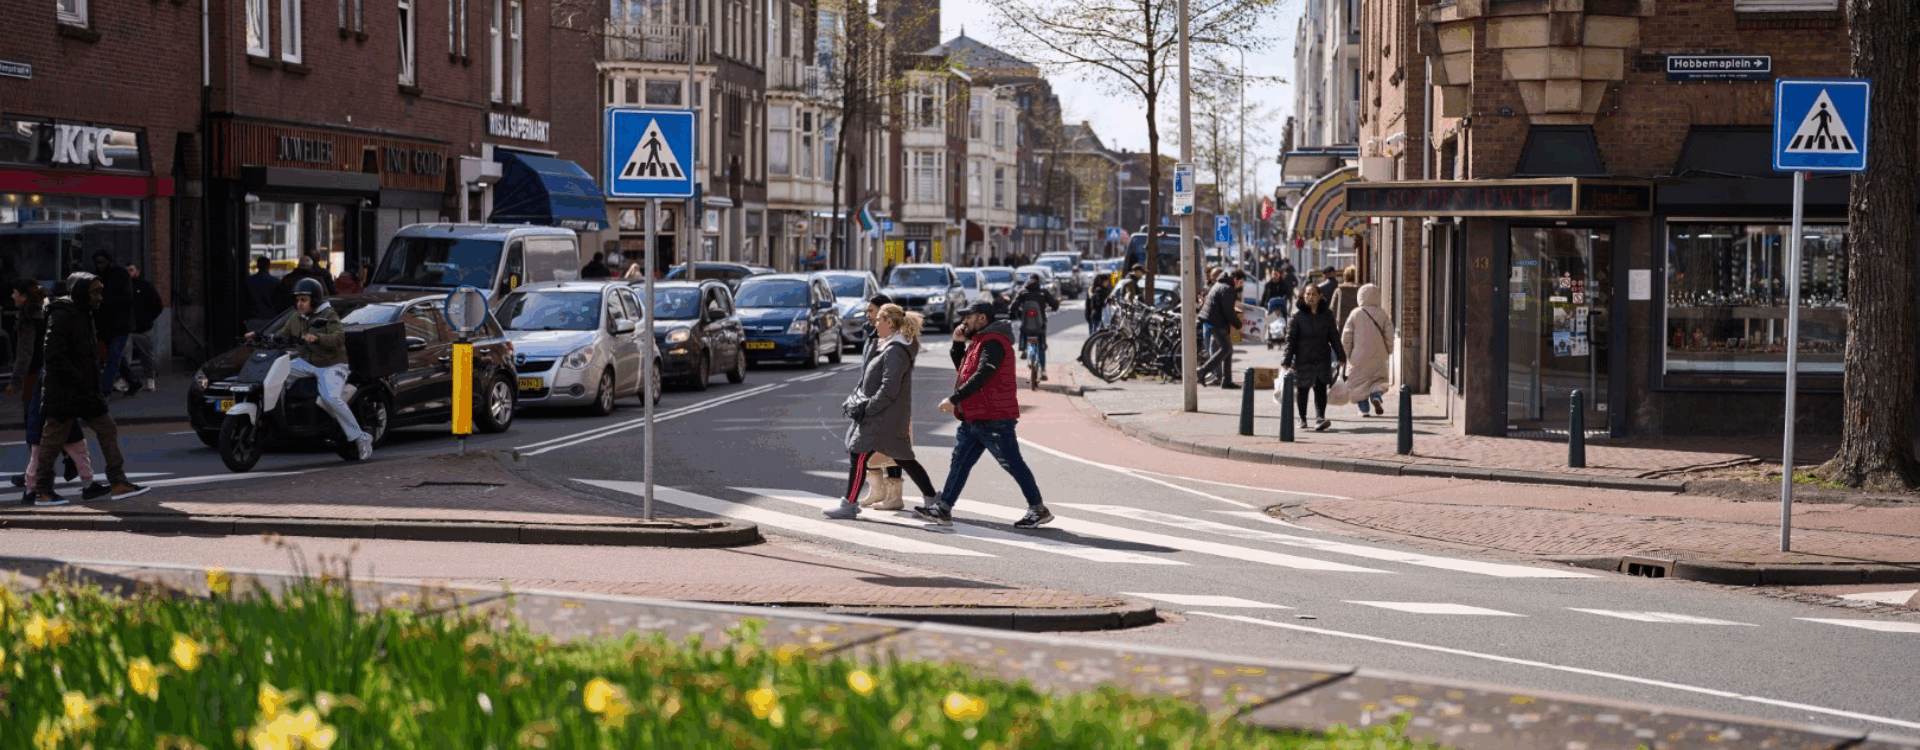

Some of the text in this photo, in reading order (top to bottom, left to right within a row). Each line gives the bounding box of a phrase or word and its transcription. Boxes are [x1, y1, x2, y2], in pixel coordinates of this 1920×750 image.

[1674, 59, 1751, 69] Hobbemaplein
[51, 124, 114, 167] KFC
[510, 115, 550, 143] SUPERMARKT
[279, 136, 333, 163] JUWELIER
[414, 150, 444, 174] GOLD
